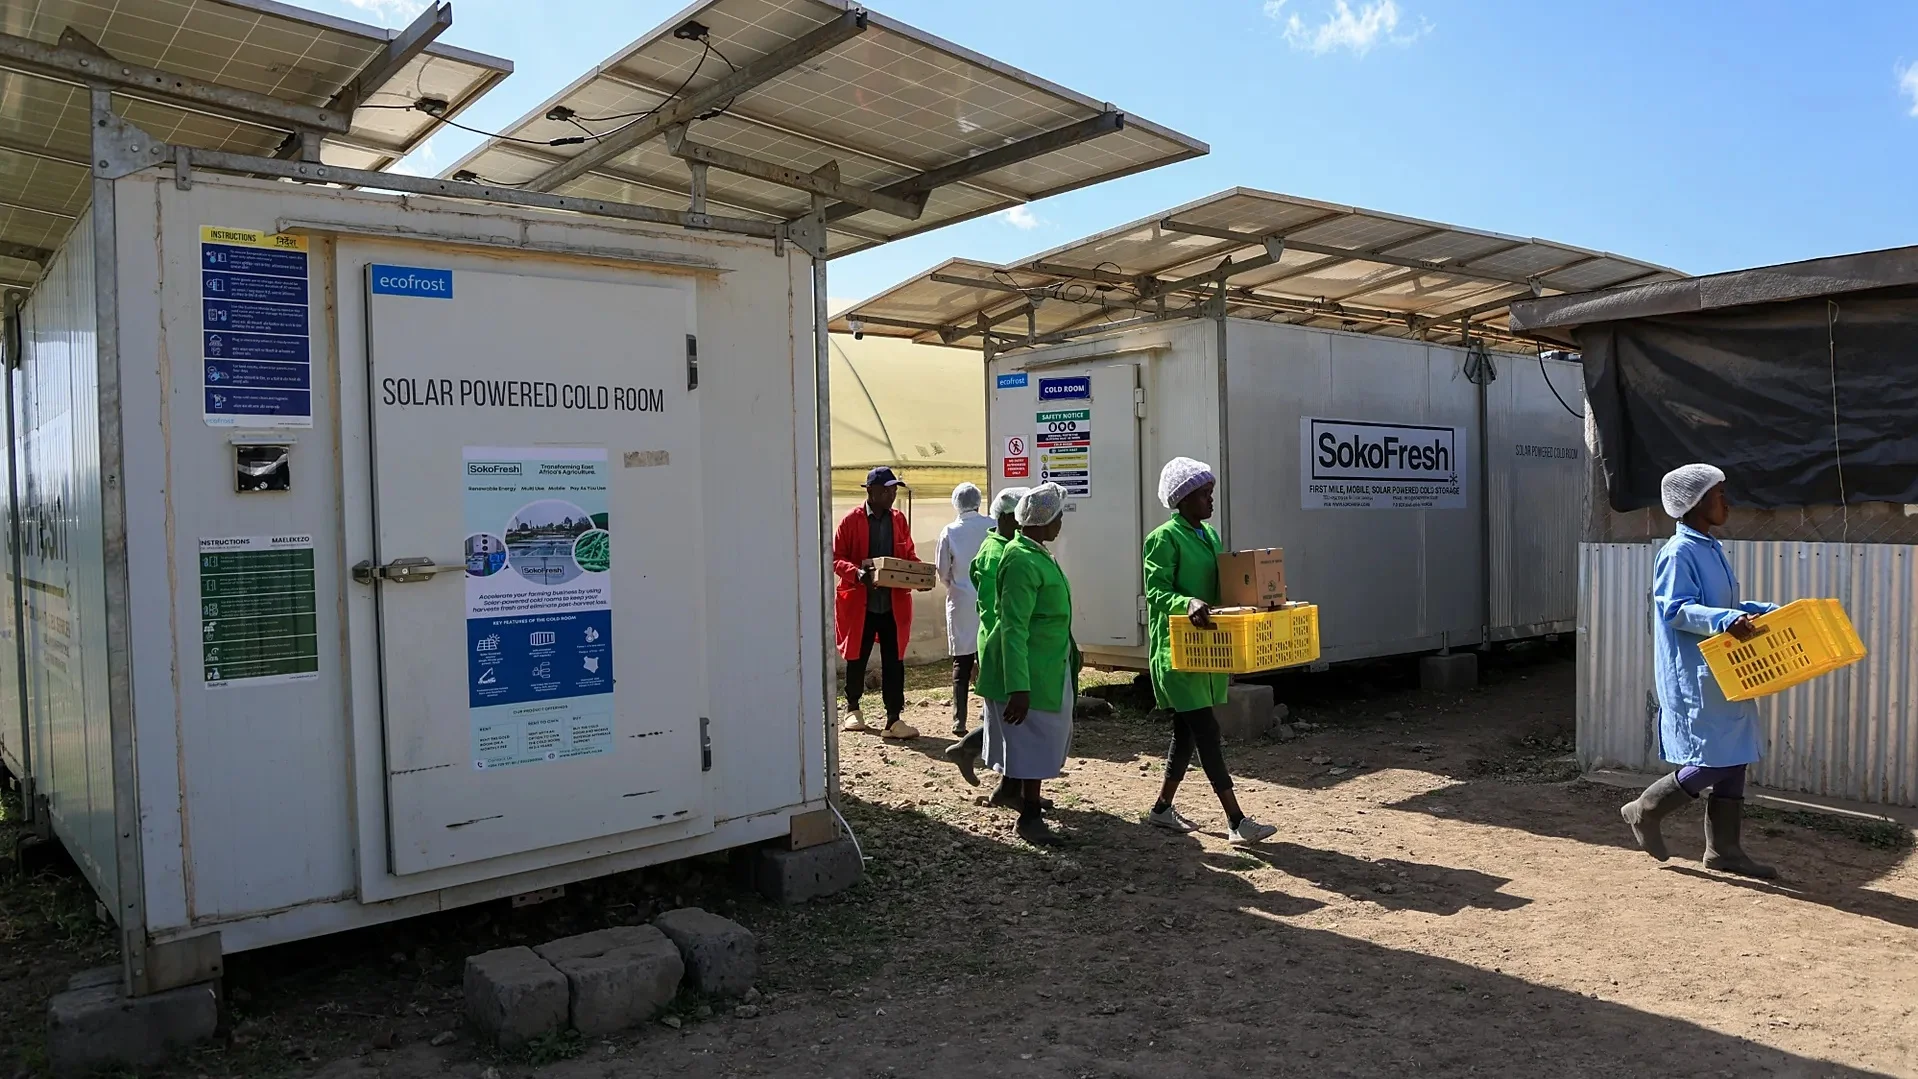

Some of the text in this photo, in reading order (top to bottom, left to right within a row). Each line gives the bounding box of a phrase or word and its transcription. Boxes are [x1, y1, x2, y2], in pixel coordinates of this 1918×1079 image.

[210, 230, 256, 242] INSTRUCTIONS
[276, 236, 296, 245] निर्देश
[379, 274, 445, 292] ecofrost
[999, 378, 1025, 386] ecofrost
[382, 378, 664, 412] SOLAR POWERED COLD ROOM
[1318, 432, 1449, 471] SokoFresh
[1516, 444, 1578, 459] SOLAR POWERED COLD ROOM
[470, 465, 520, 473] SokoFresh
[1328, 485, 1345, 494] MILE,
[1346, 486, 1371, 495] MOBILE,
